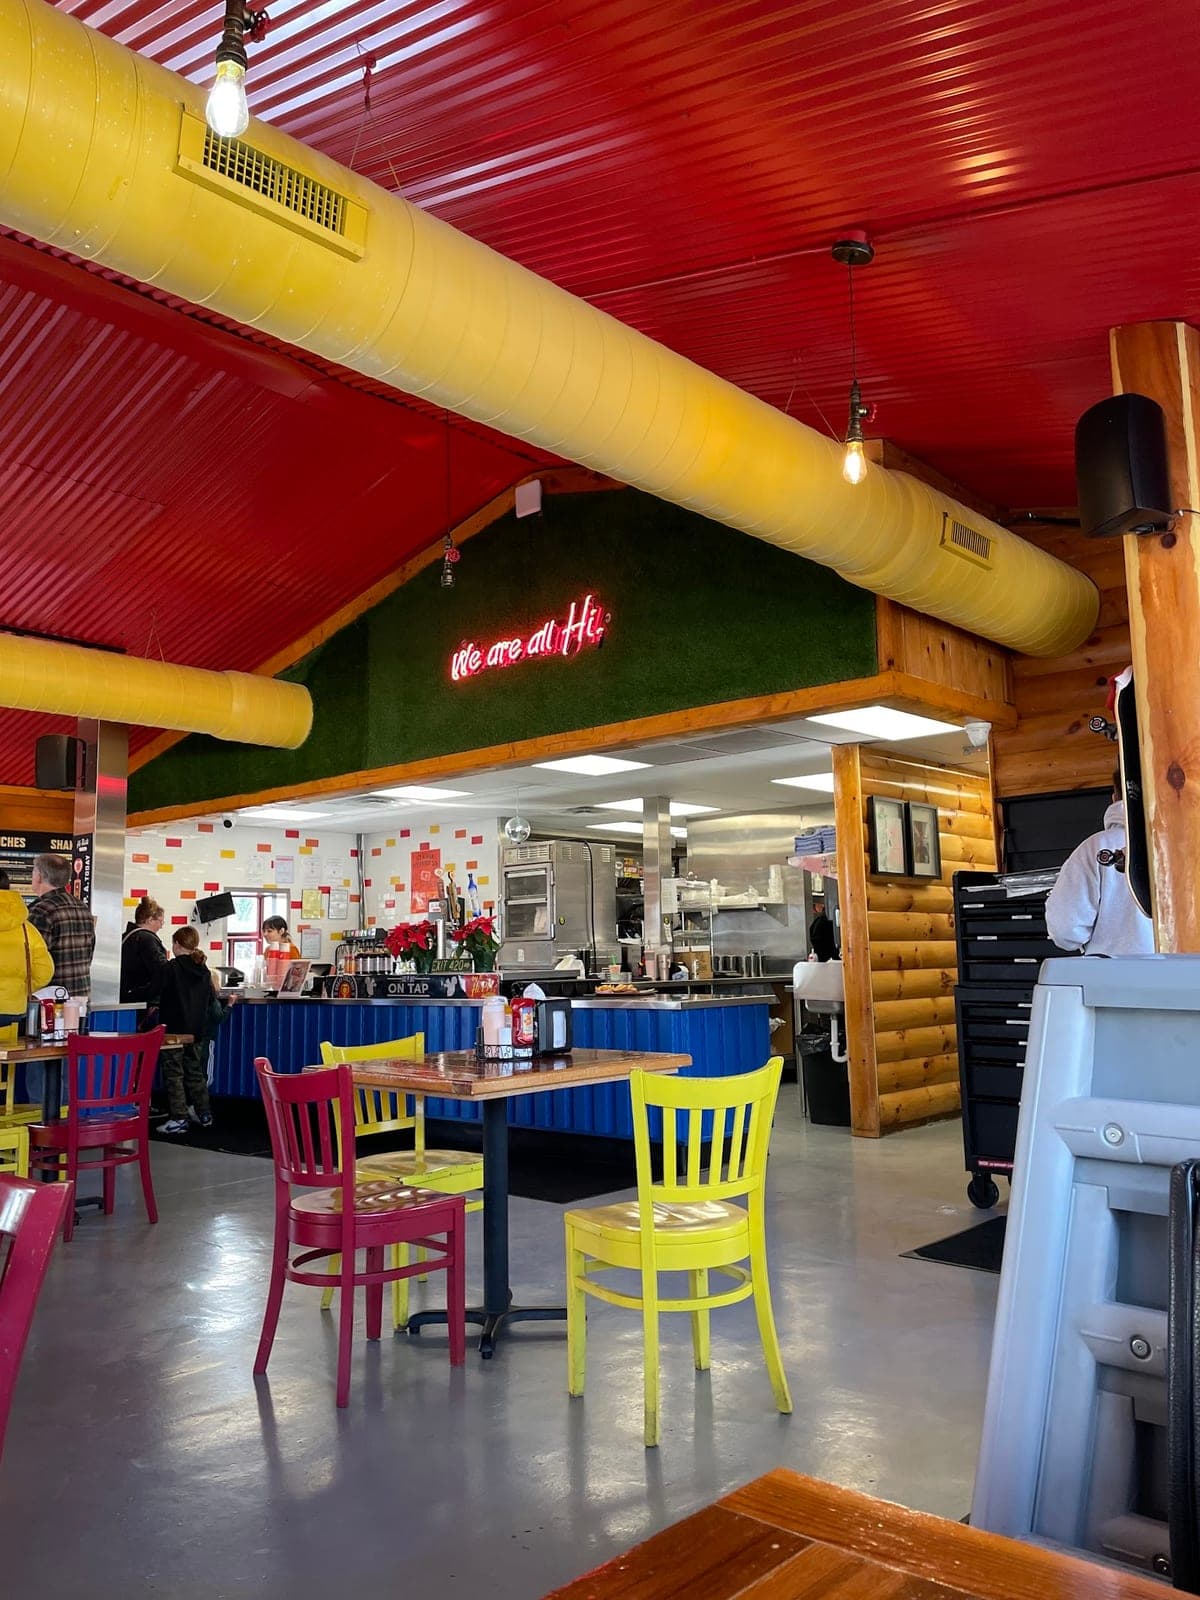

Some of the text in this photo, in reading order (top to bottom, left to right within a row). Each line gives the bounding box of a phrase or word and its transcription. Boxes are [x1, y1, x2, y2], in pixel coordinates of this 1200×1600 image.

[451, 643, 482, 681] We
[487, 637, 523, 666] are
[527, 619, 557, 655] all
[432, 960, 464, 972] EXIT 420
[388, 983, 429, 994] ON TAP
